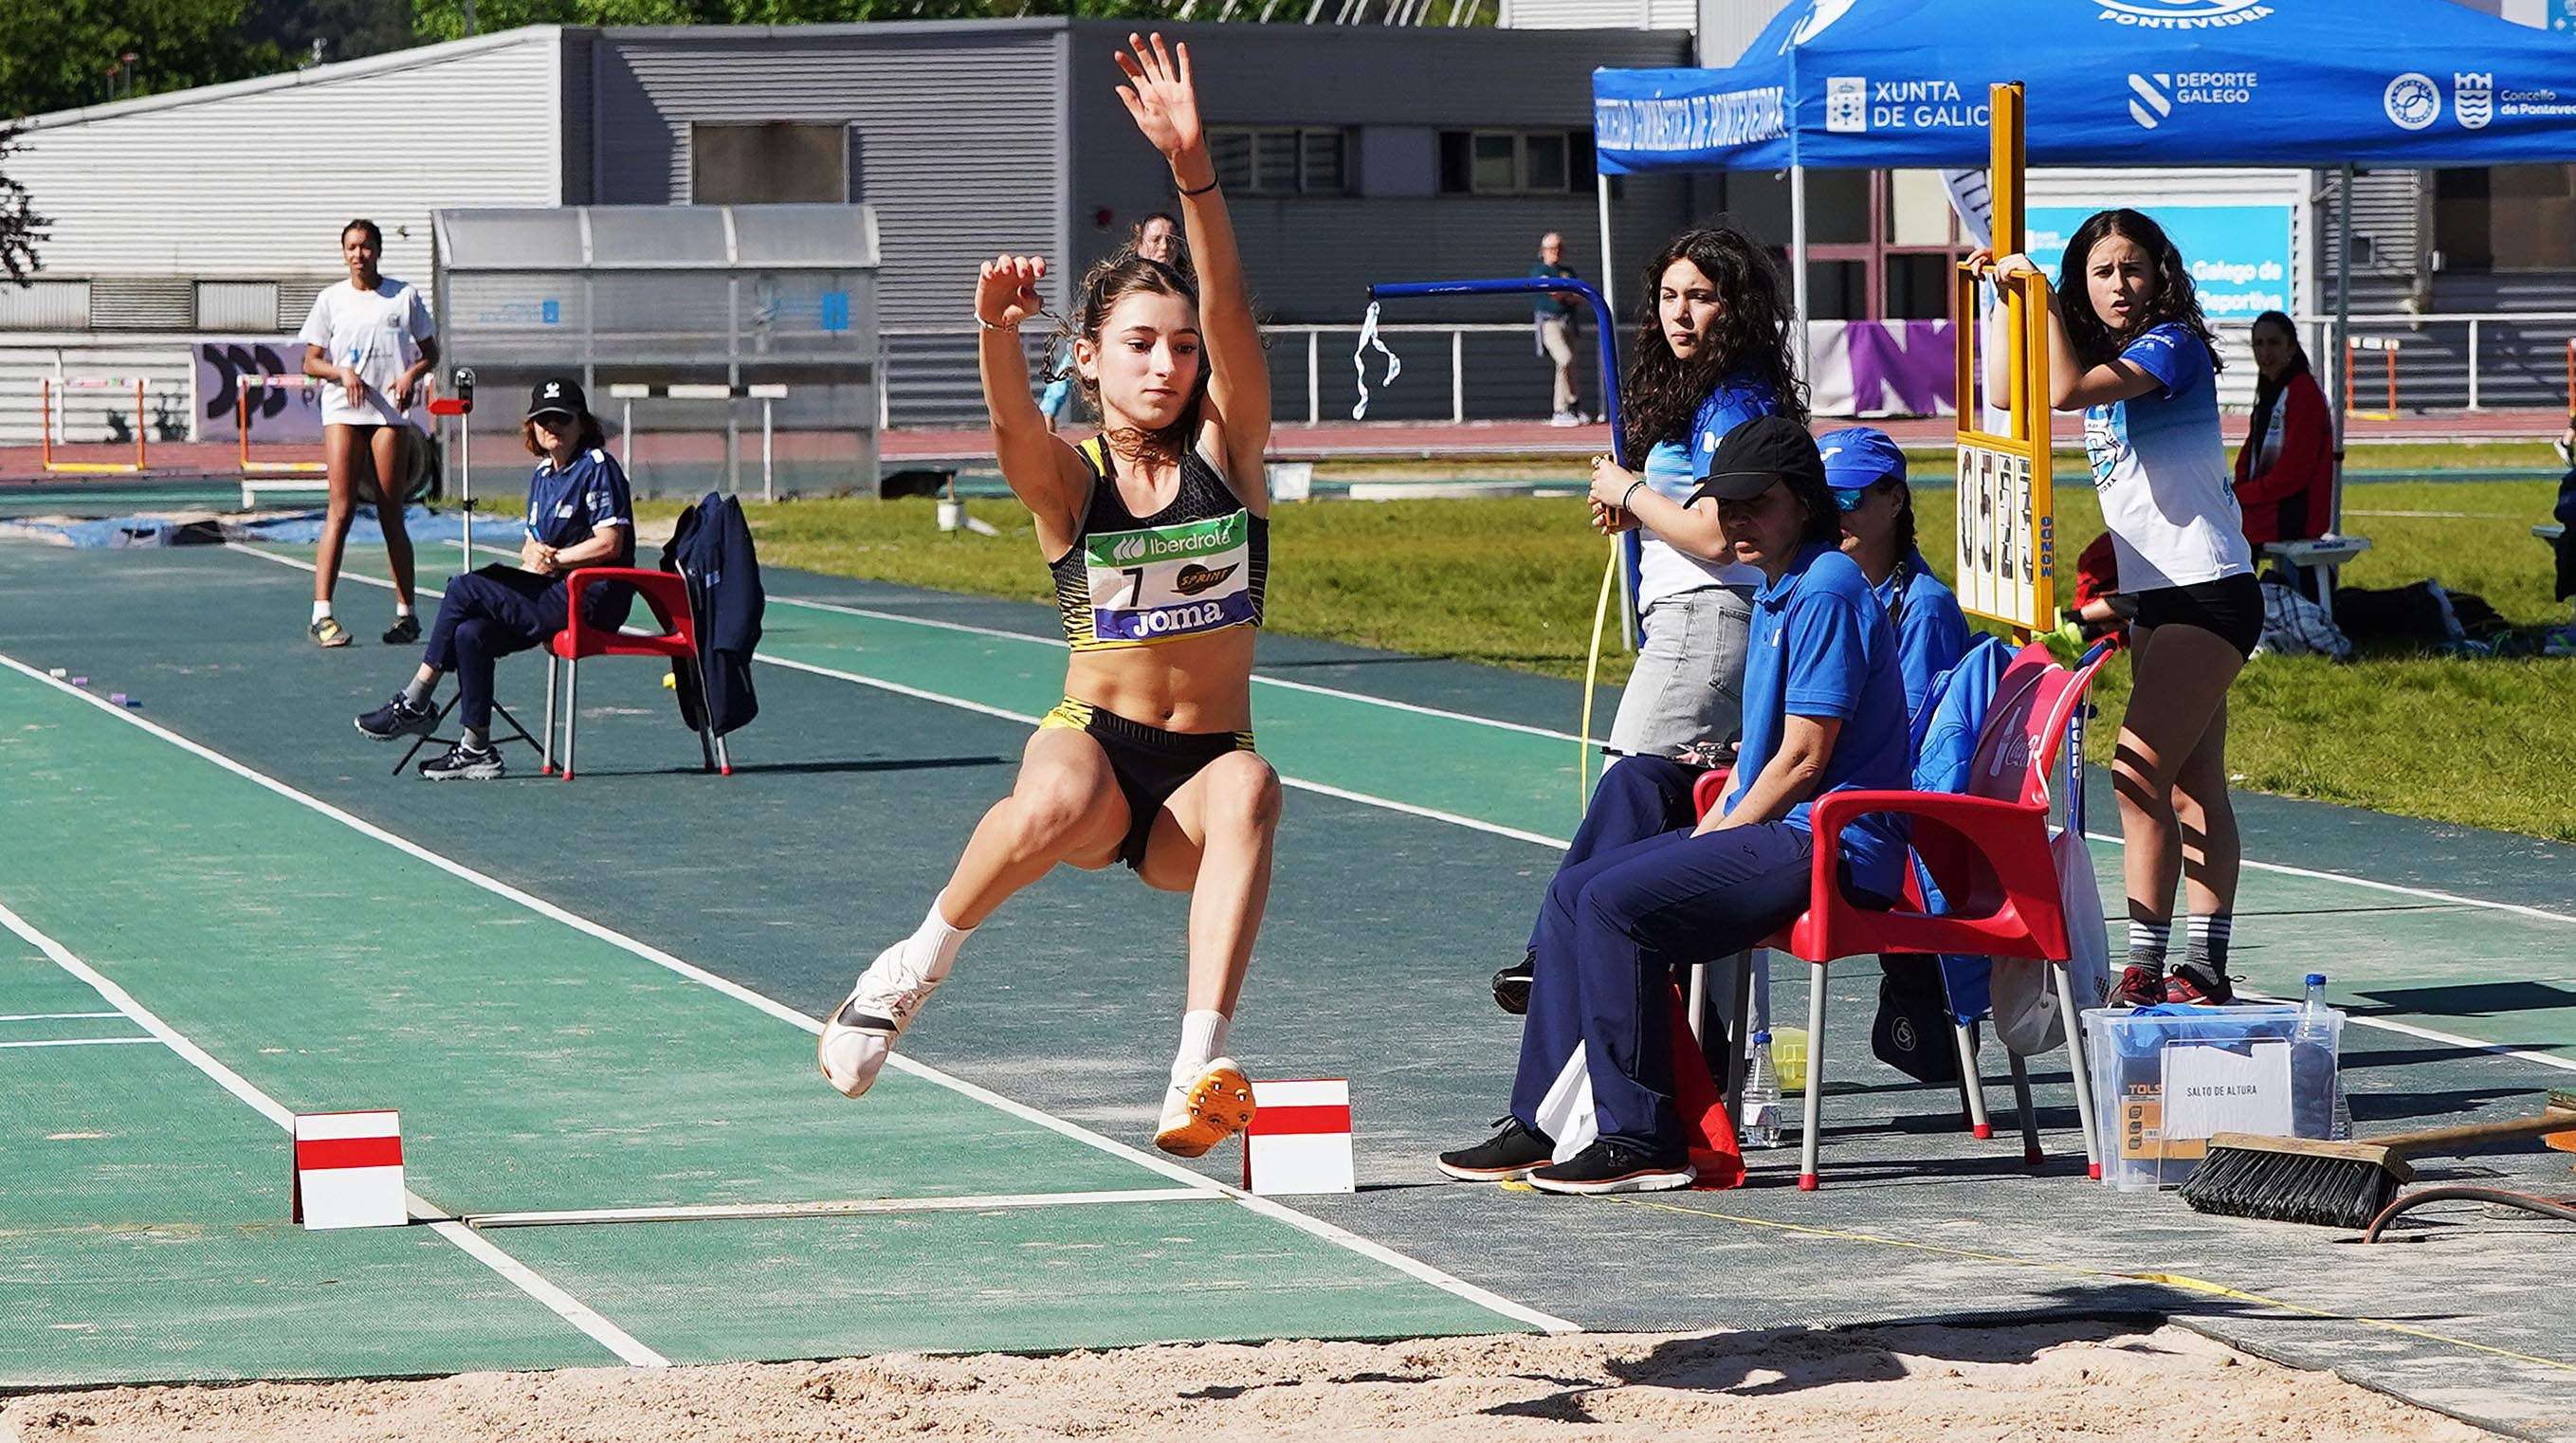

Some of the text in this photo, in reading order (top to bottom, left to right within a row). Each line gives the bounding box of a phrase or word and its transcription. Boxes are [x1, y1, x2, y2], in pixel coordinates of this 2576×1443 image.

[2098, 6, 2275, 29] PONTEVEDRA
[2177, 72, 2257, 87] DEPORTE
[1875, 81, 1961, 102] XUNTA
[2177, 89, 2250, 103] GALEGO
[1873, 106, 1906, 127] DE
[2501, 103, 2518, 115] de
[1150, 529, 1231, 555] Iberdrola
[1123, 567, 1143, 607] 7
[2186, 1085, 2257, 1097] SALTO DE ALTURA
